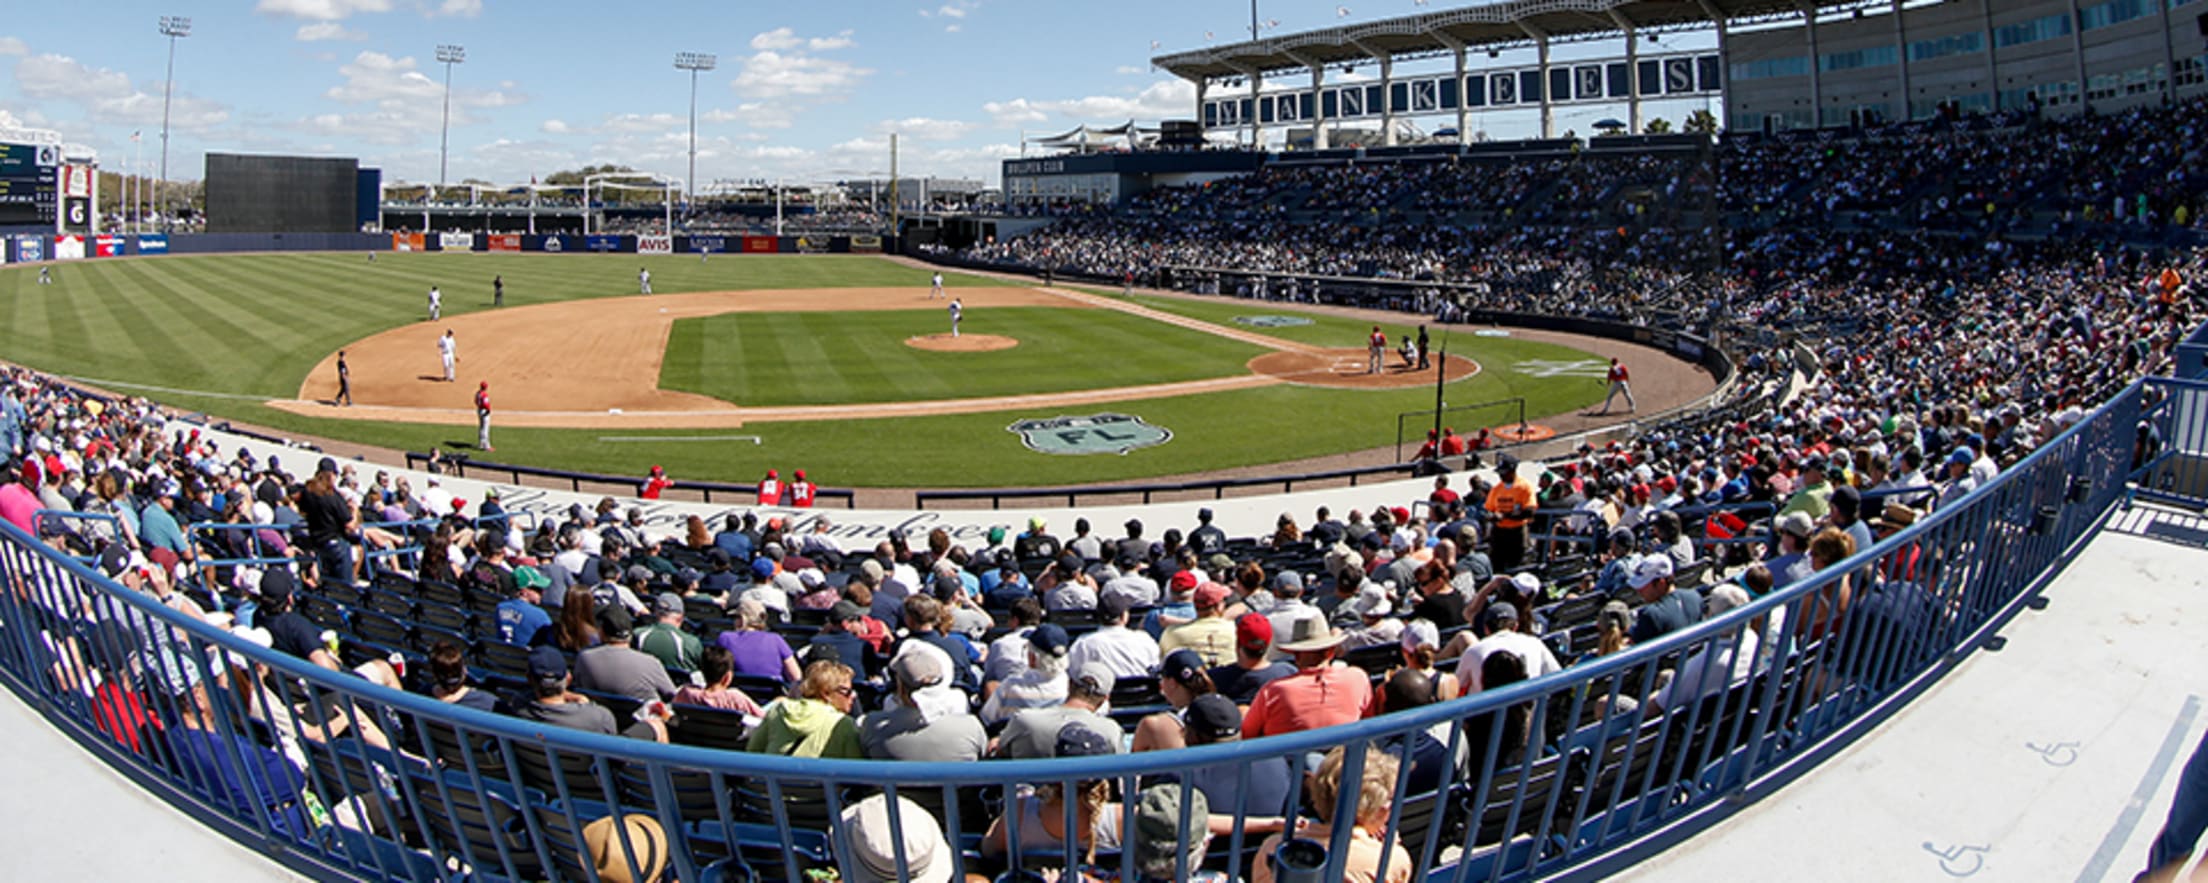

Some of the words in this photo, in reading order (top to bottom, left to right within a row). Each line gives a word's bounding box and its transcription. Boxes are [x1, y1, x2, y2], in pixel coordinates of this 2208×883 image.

[1219, 51, 1693, 124] YANKEES
[70, 204, 84, 224] G
[638, 238, 670, 250] AVIS
